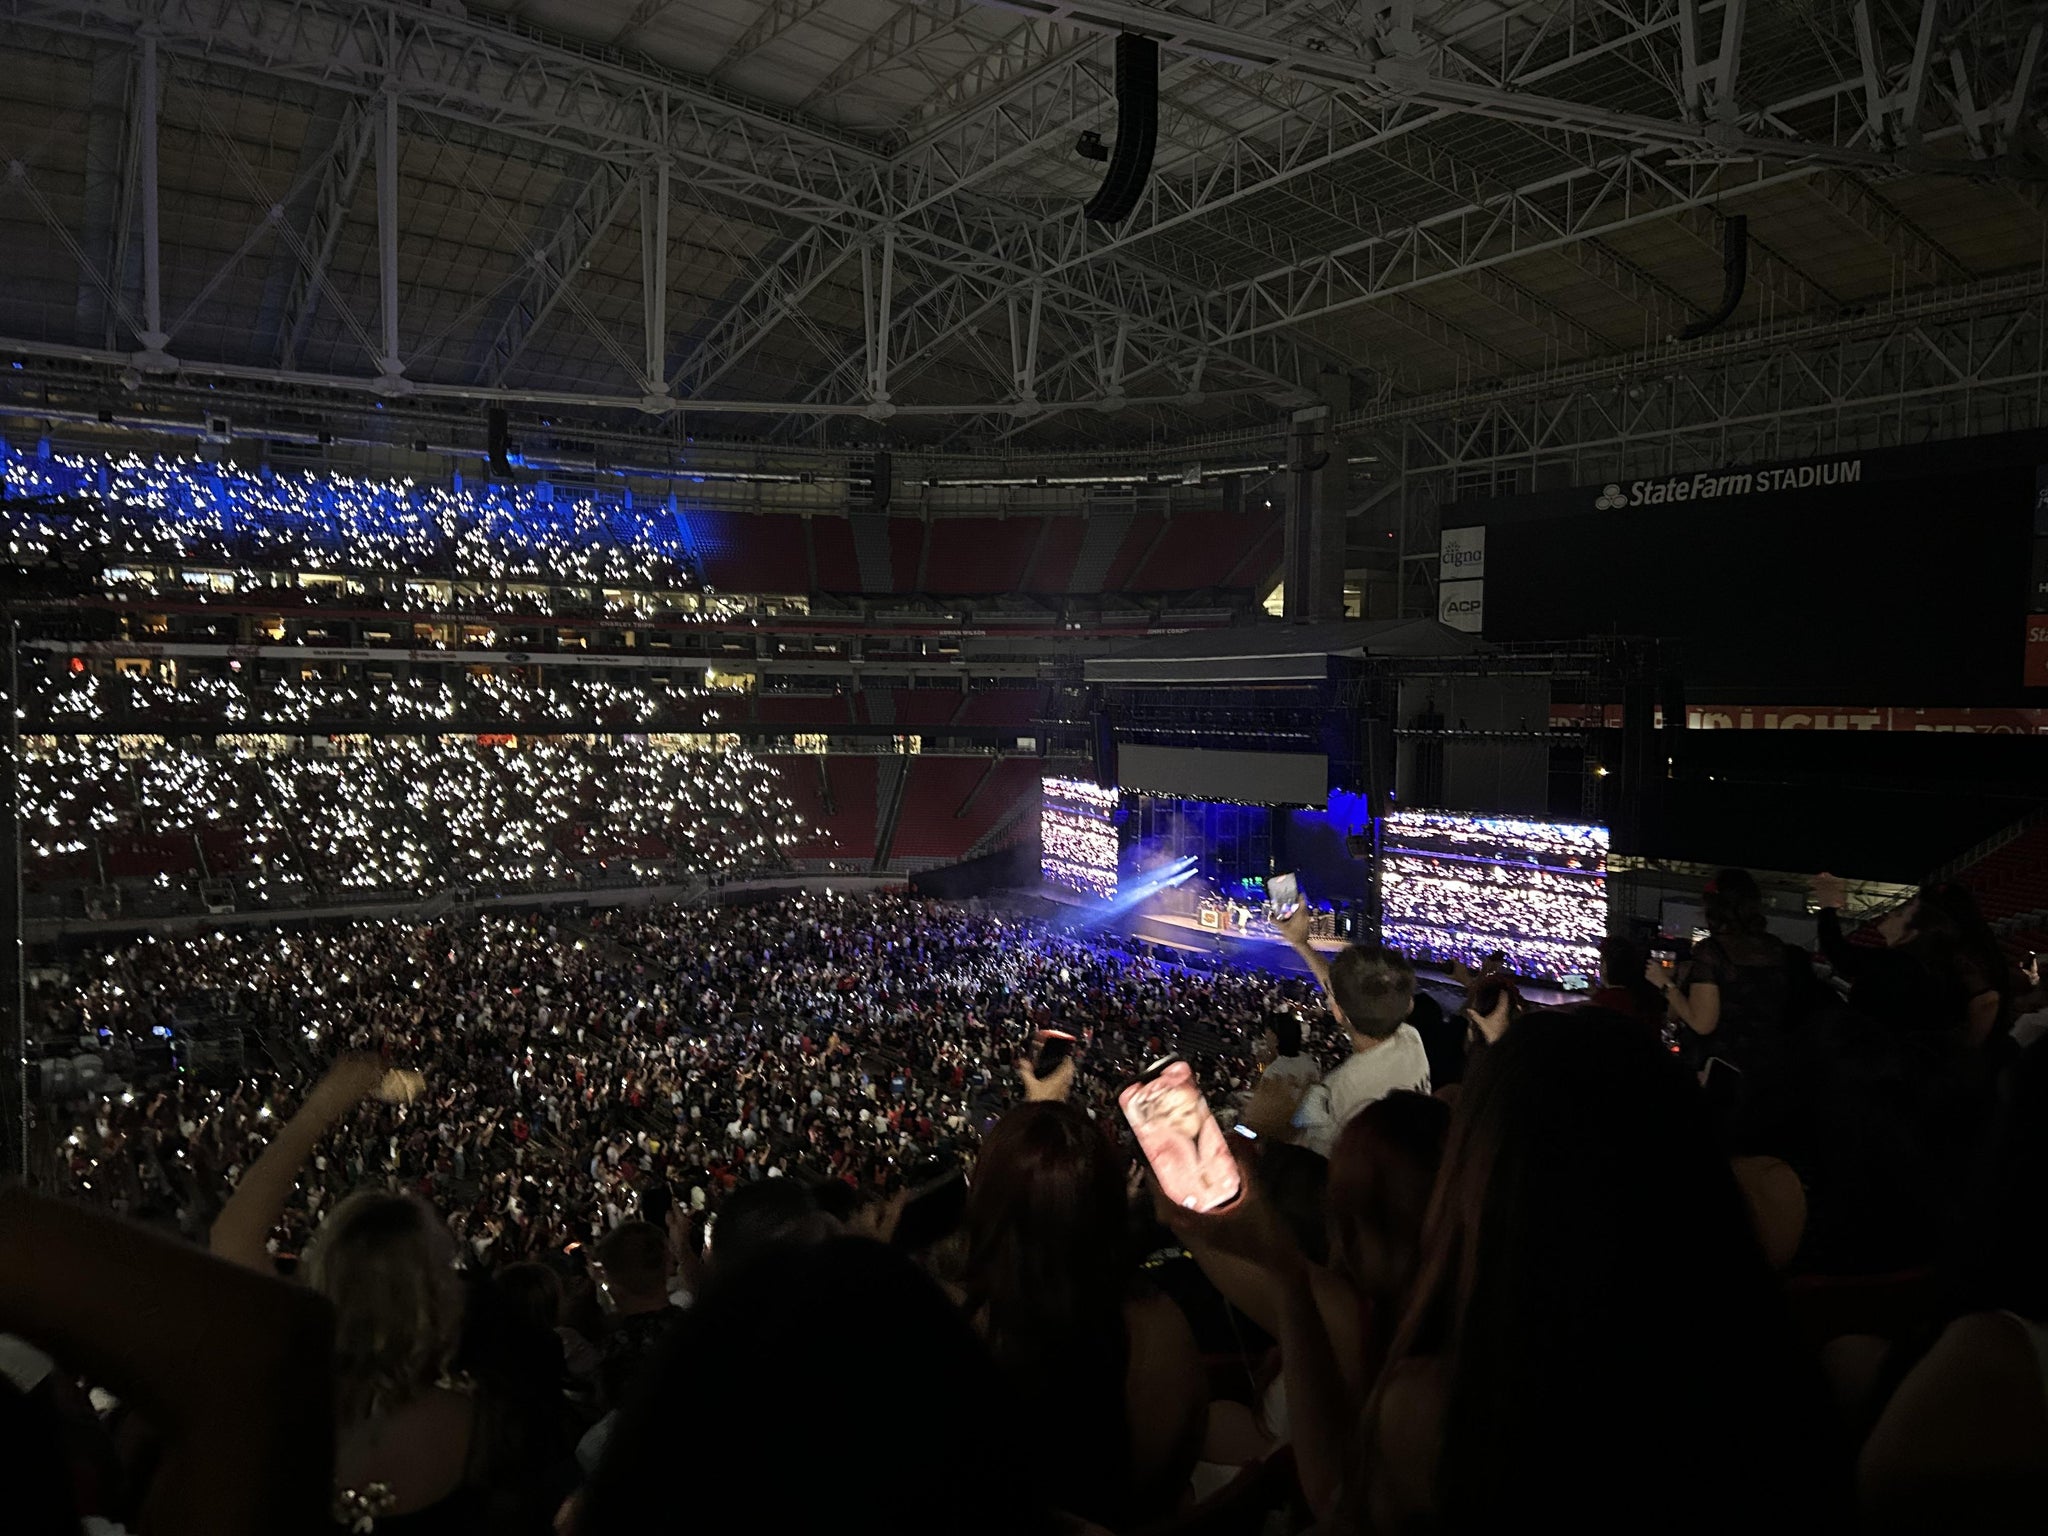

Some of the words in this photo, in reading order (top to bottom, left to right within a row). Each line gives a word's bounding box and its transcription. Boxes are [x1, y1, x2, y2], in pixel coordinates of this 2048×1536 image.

[1756, 460, 1862, 492] STADIUM
[1443, 550, 1482, 567] cigna
[1448, 600, 1481, 613] ACP
